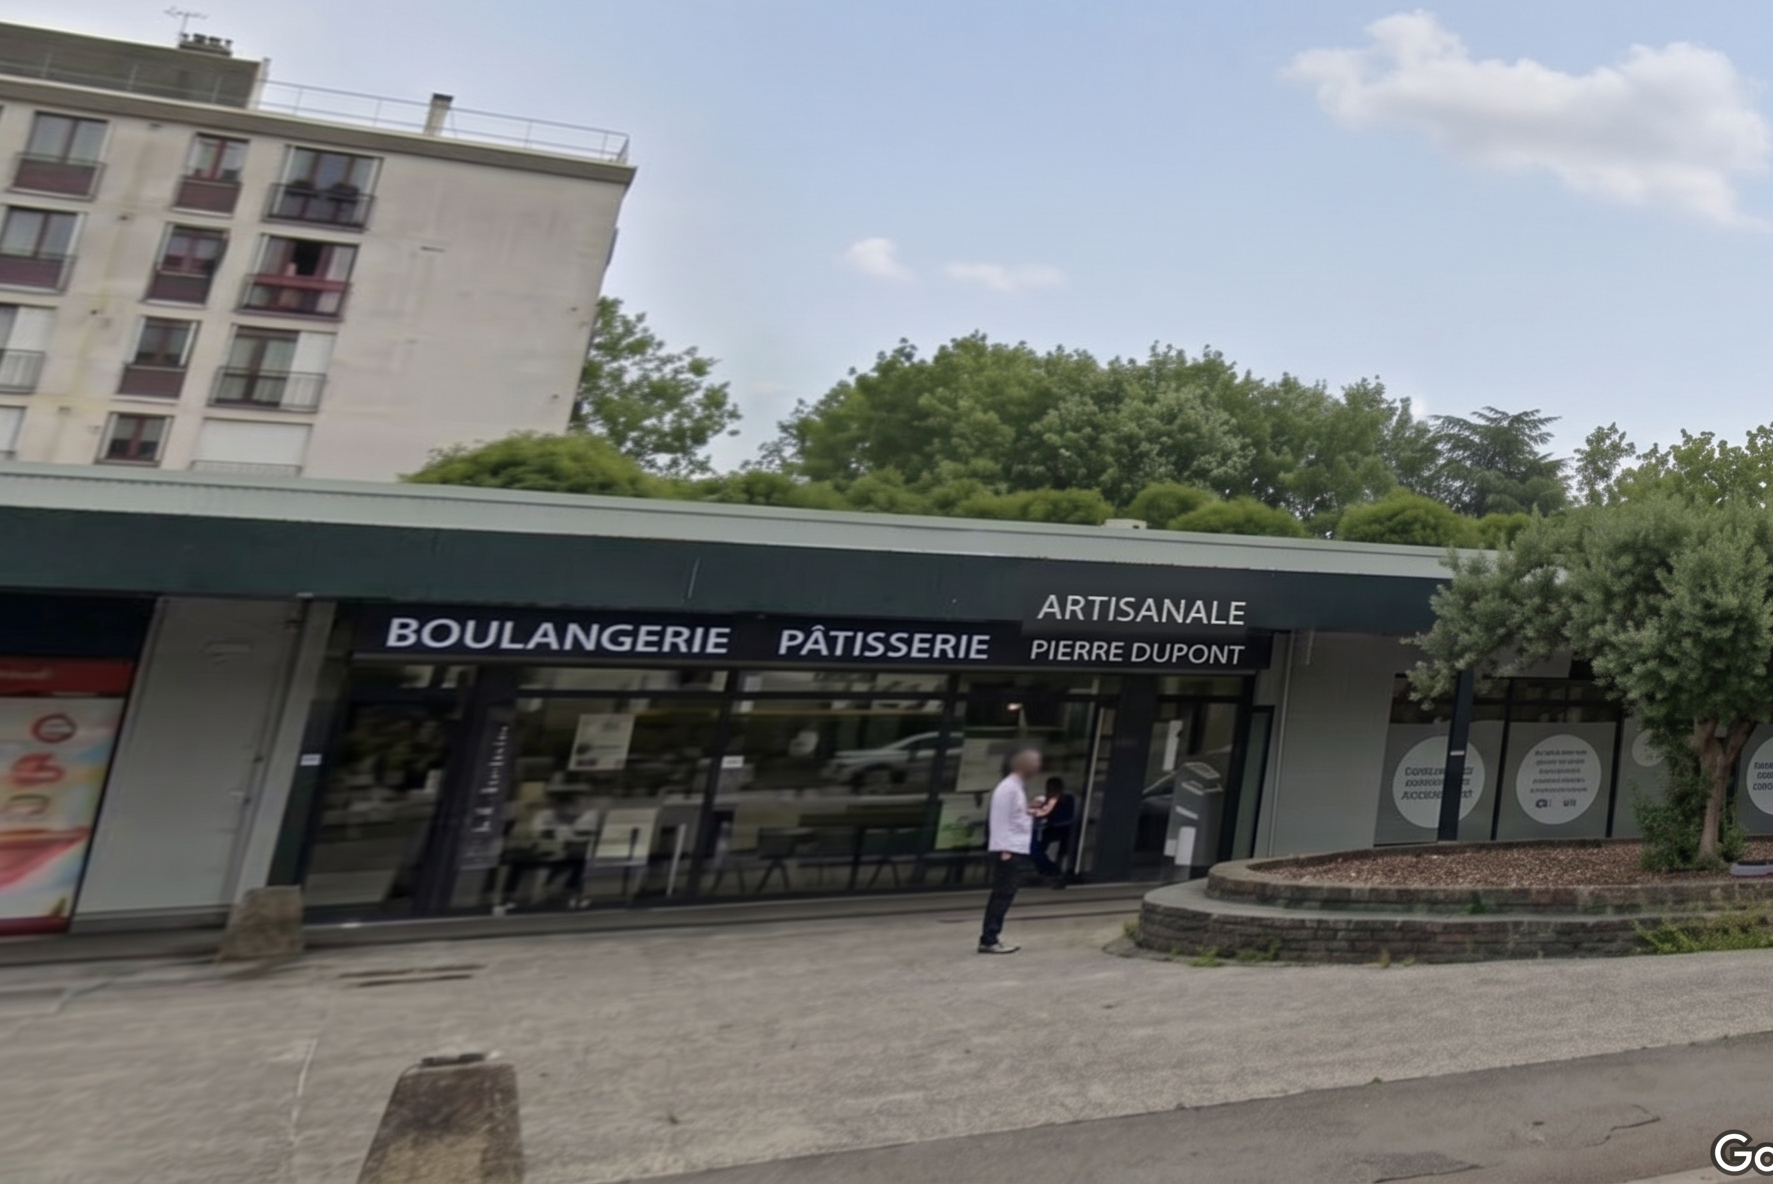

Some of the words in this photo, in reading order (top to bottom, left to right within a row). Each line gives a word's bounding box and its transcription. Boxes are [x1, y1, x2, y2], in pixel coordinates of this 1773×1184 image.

[1037, 594, 1247, 625] ARTISANALE
[385, 616, 730, 654] BOULANGERIE
[778, 625, 990, 660] PÂTISSERIE
[1030, 639, 1125, 662] PIERRE
[1131, 642, 1245, 665] DUPONT
